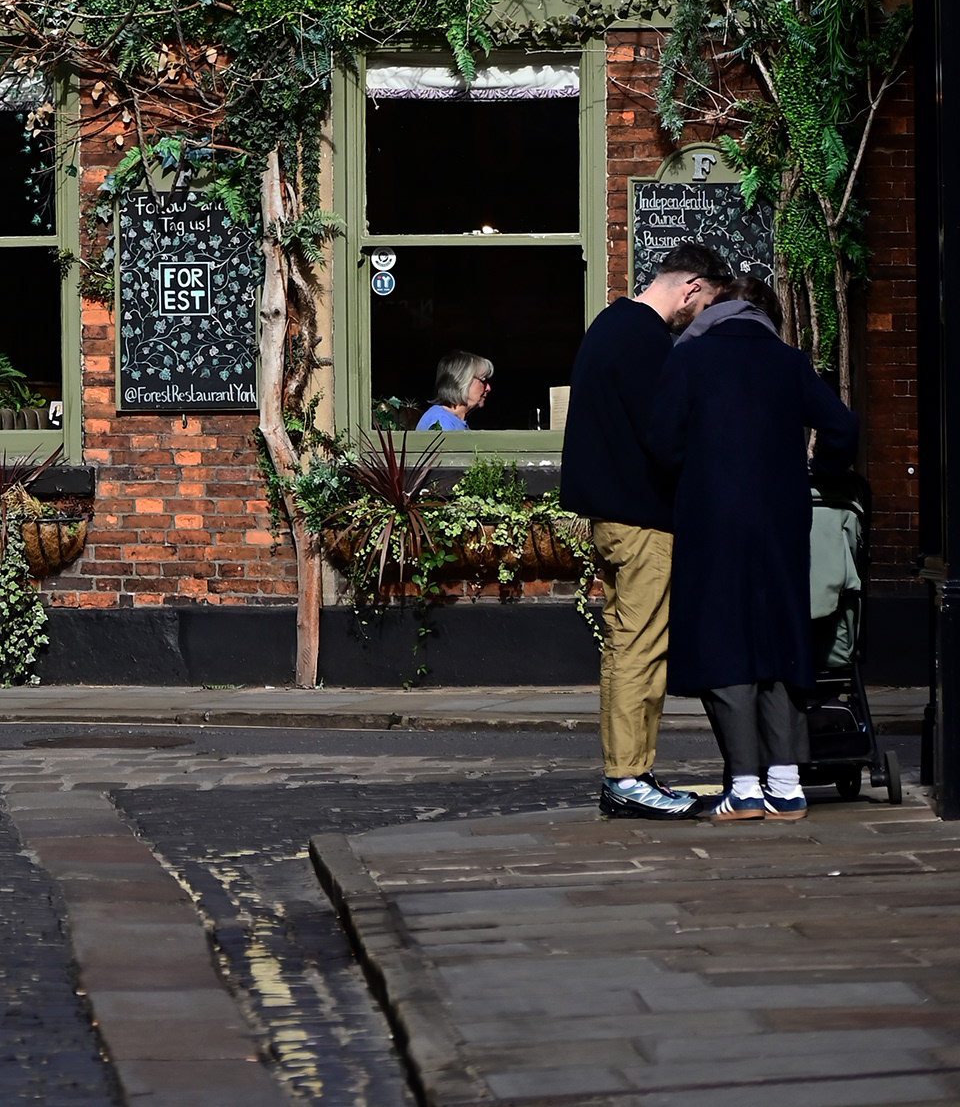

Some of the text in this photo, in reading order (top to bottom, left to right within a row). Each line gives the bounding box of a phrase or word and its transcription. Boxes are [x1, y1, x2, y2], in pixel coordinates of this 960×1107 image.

[691, 154, 717, 181] F
[639, 190, 715, 216] Independently
[158, 215, 211, 237] Tag us!
[643, 230, 695, 247] Business
[164, 268, 204, 288] FOR
[164, 290, 205, 310] EST
[124, 383, 257, 403] @ForestRestaurantYork
